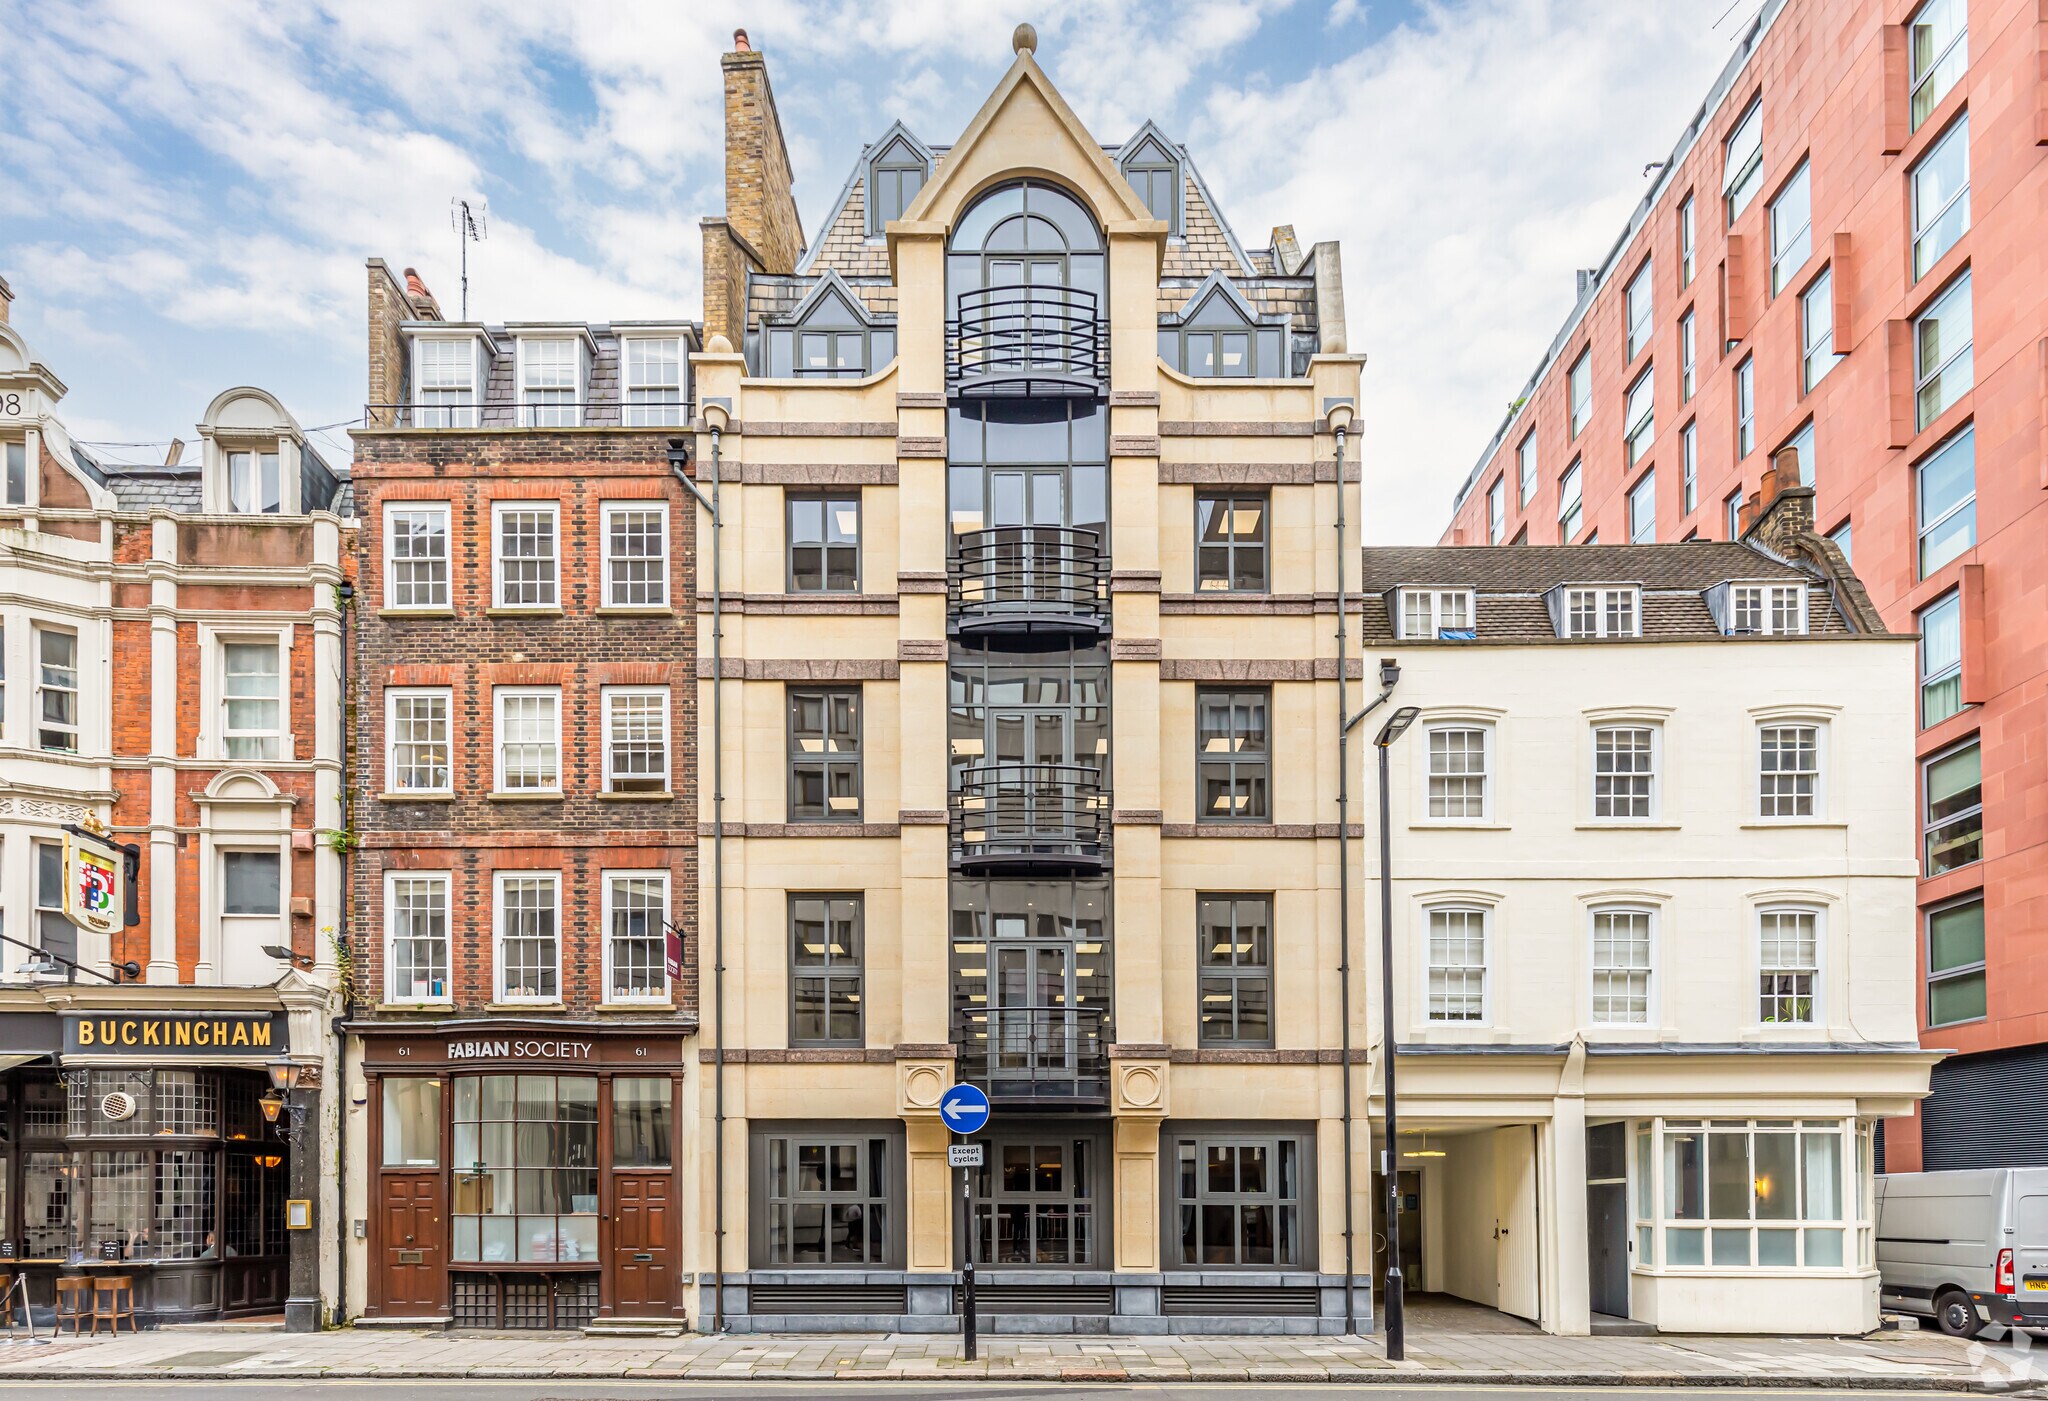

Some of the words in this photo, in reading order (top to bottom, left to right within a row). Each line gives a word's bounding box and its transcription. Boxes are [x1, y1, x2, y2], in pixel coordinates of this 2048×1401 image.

[0, 393, 21, 416] 8
[79, 1020, 271, 1046] BUCKINGHAM
[398, 1047, 410, 1056] 61
[448, 1041, 510, 1059] FABIAN
[514, 1041, 592, 1059] SOCIETY
[635, 1047, 647, 1056] 61
[952, 1147, 979, 1156] Except
[953, 1155, 979, 1163] cycles
